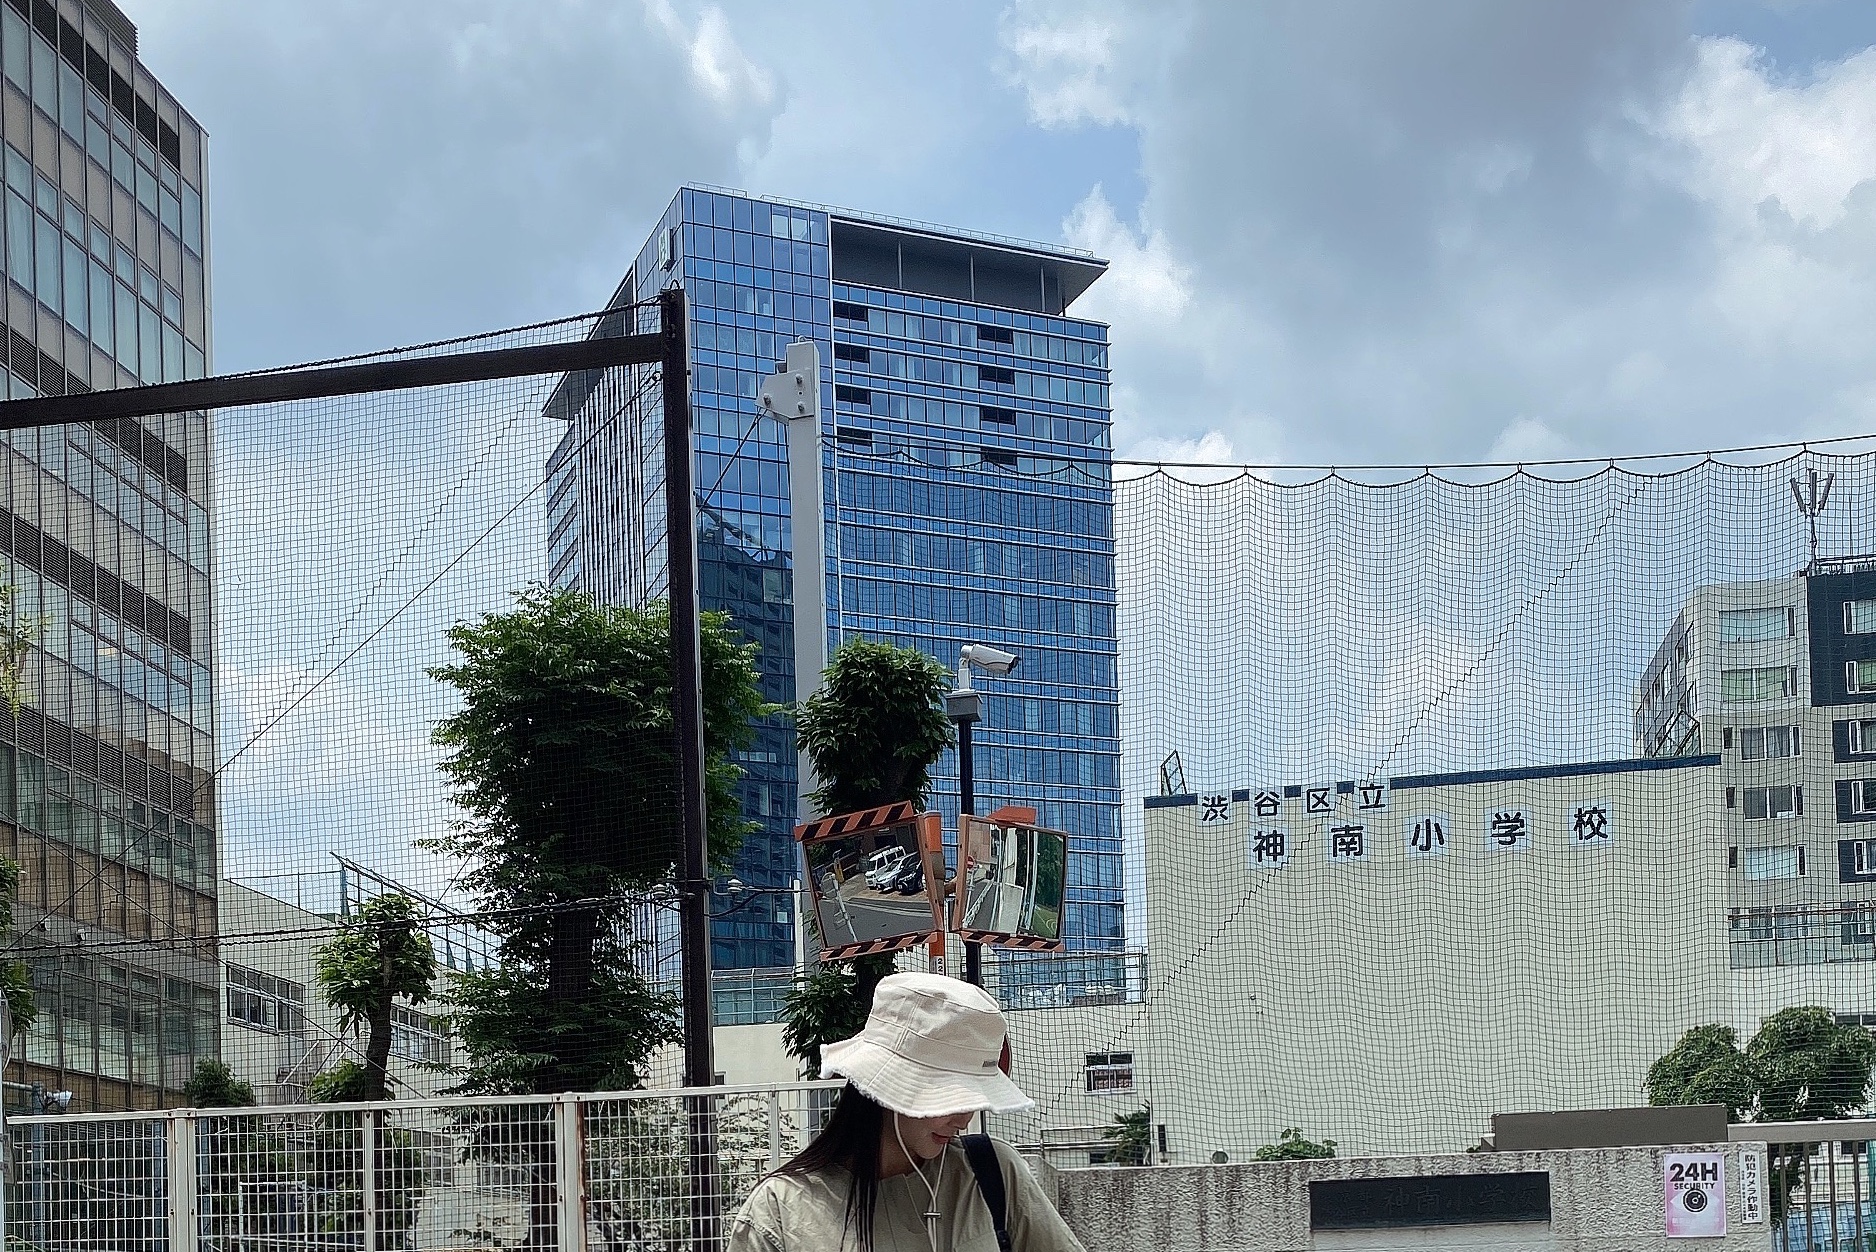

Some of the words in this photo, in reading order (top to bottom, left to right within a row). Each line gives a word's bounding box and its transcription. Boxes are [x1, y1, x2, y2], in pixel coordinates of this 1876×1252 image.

[1202, 783, 1387, 822] 渋谷区立
[1252, 806, 1609, 863] 神南小学校
[1669, 1162, 1718, 1183] 24H
[1674, 1182, 1716, 1191] SECURITY
[1744, 1154, 1758, 1220] 防犯カメラ作動中
